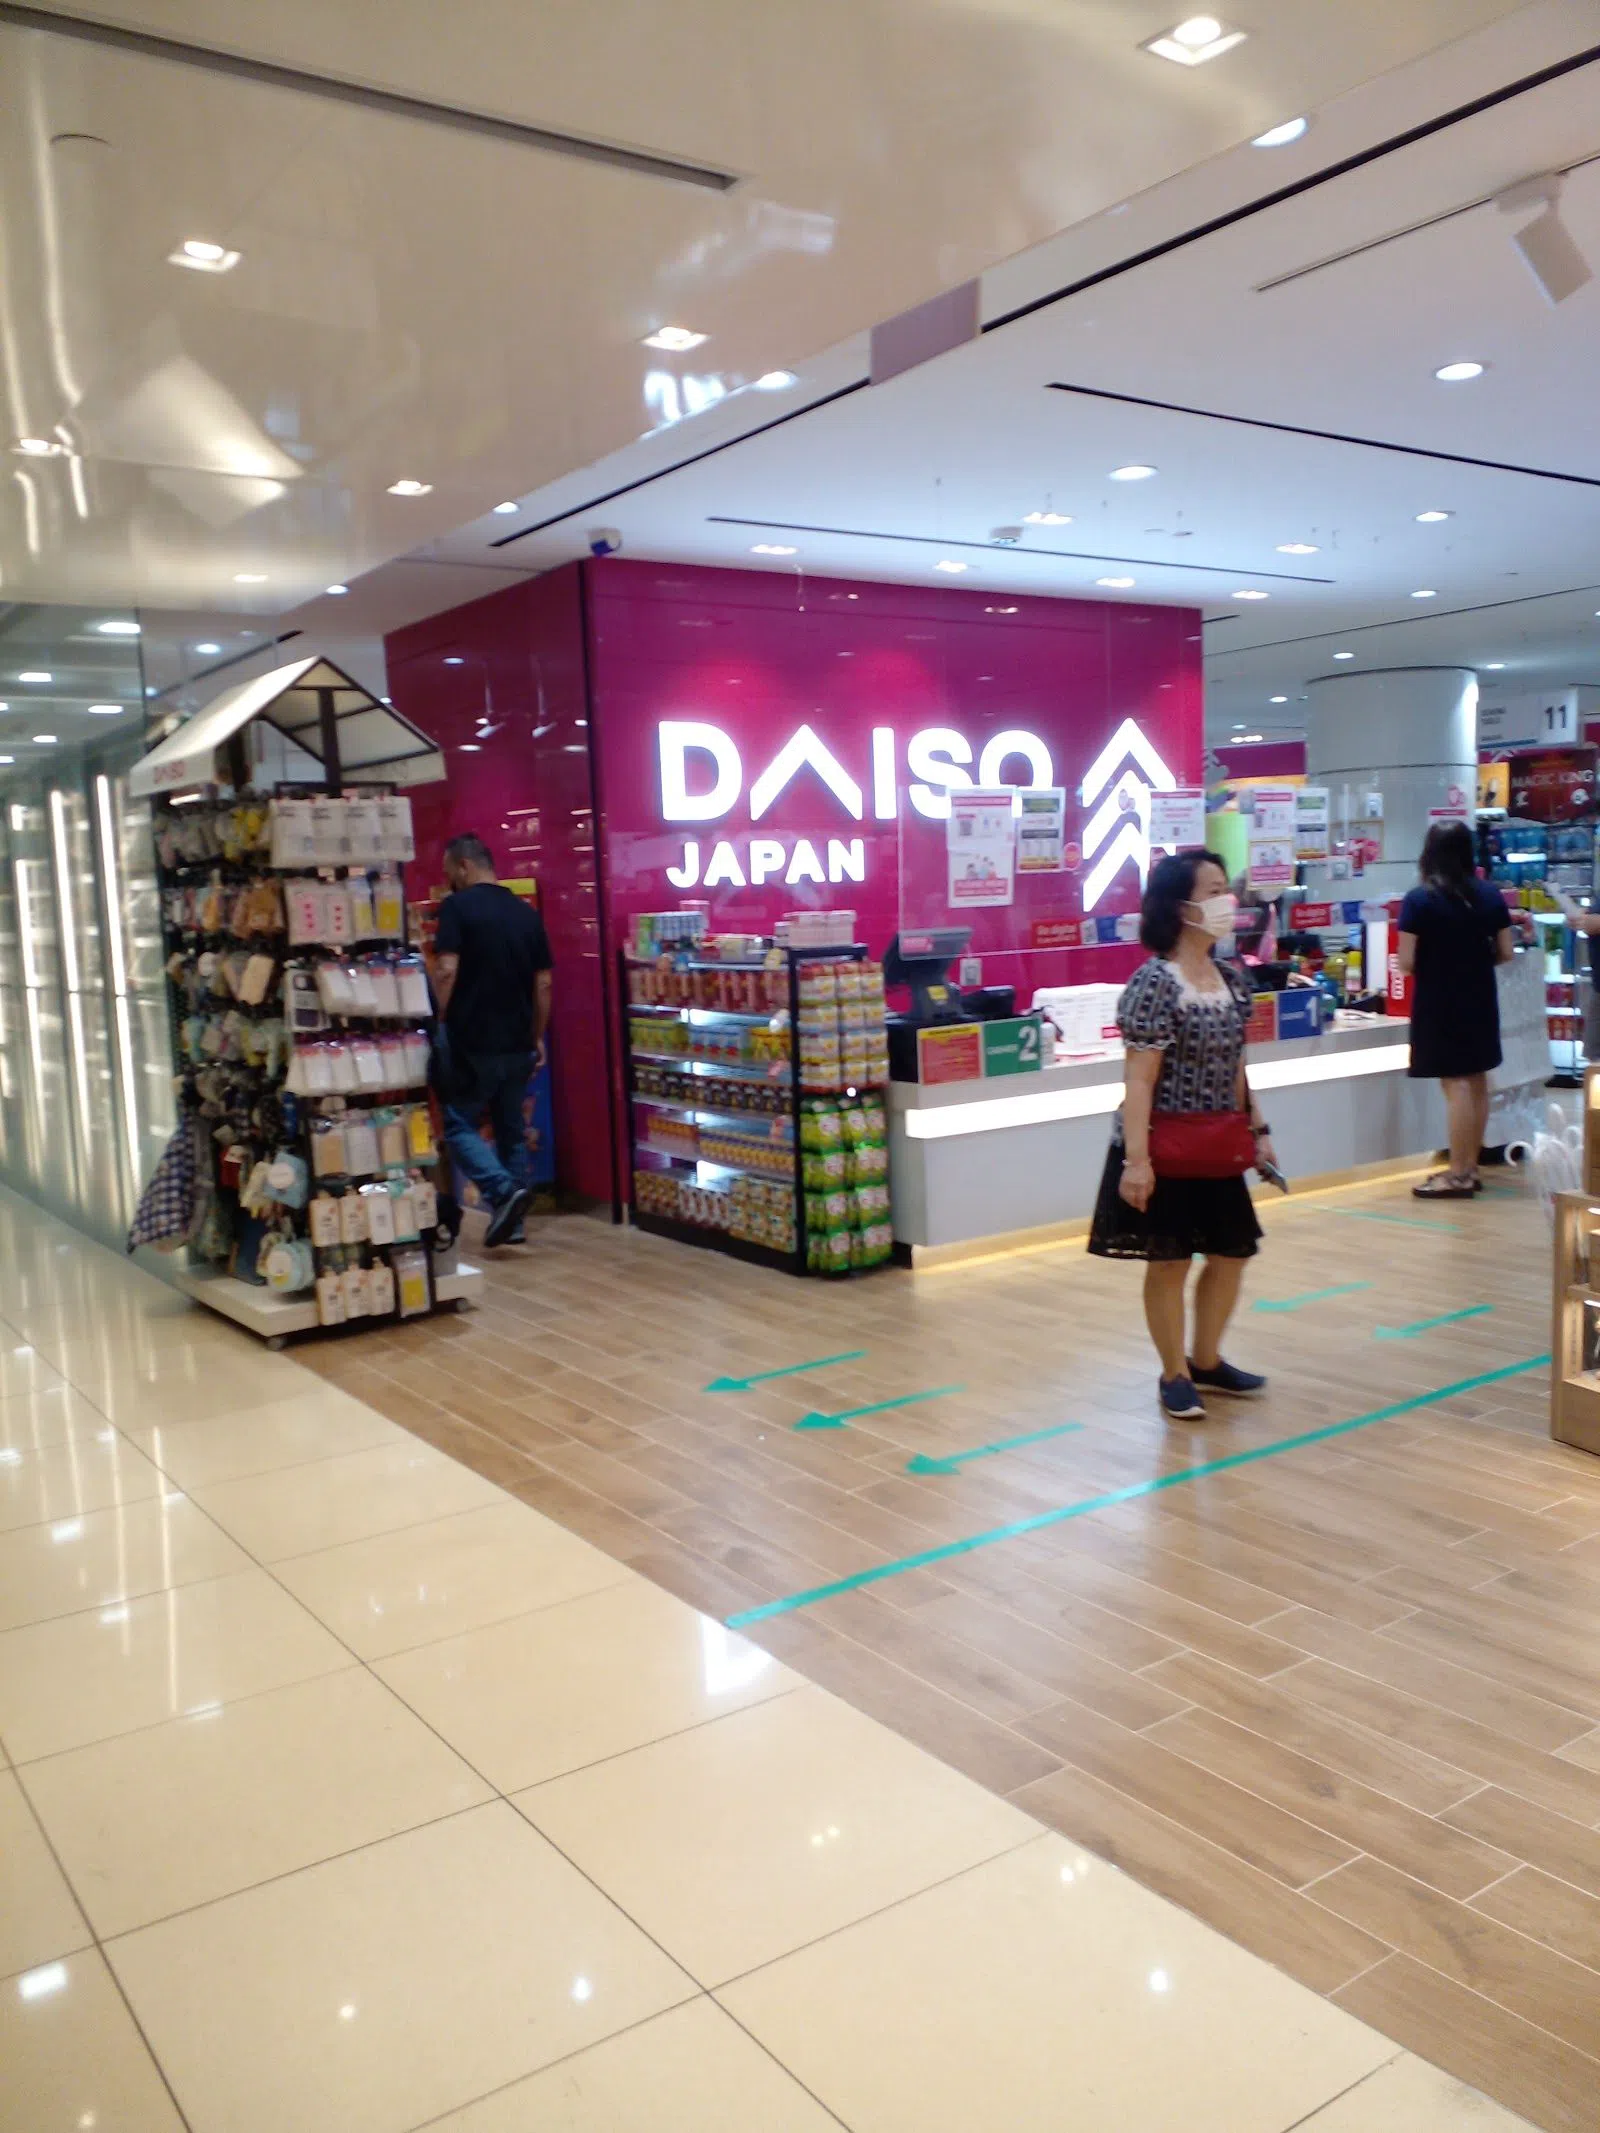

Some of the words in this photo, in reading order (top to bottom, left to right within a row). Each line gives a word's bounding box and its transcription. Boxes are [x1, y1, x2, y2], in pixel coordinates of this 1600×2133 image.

[1545, 704, 1567, 730] 11
[658, 720, 1054, 820] DAISO
[666, 838, 865, 888] JAPAN
[1305, 995, 1318, 1028] 1
[1018, 1025, 1039, 1061] 2
